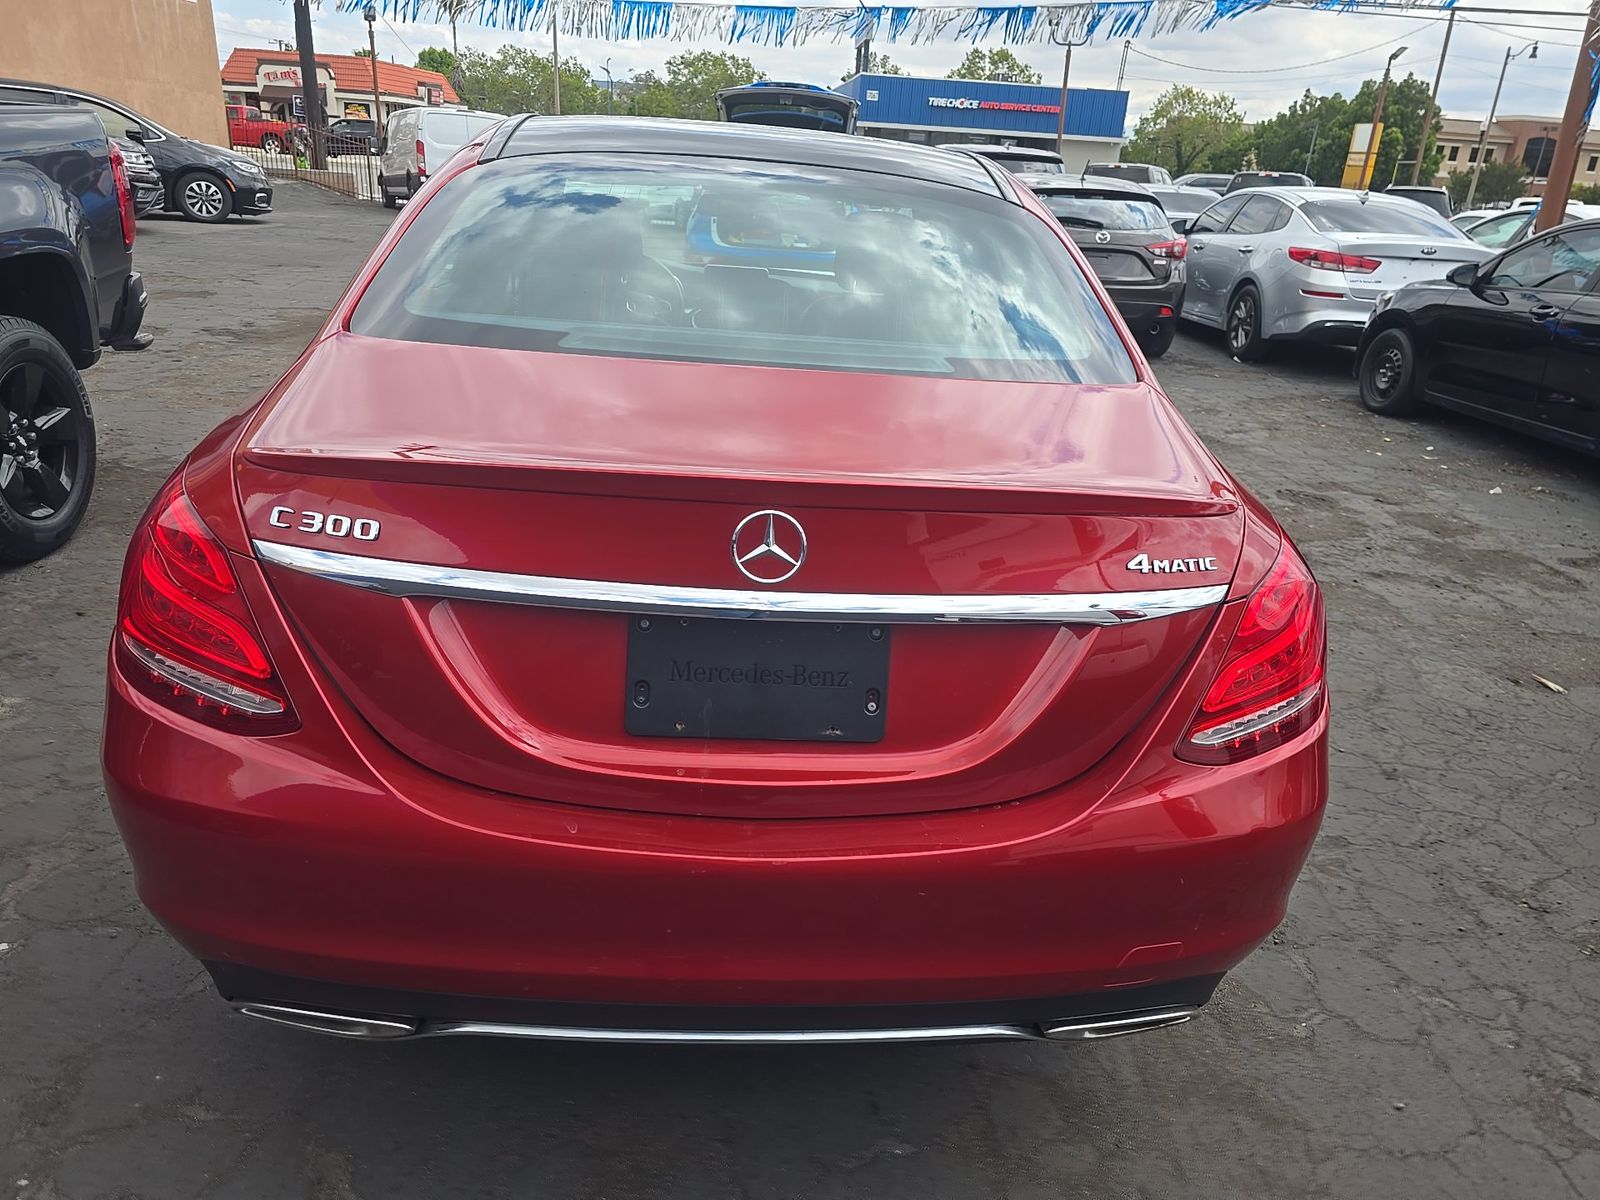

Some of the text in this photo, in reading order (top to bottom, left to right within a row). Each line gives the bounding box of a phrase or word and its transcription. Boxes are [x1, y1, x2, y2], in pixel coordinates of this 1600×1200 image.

[979, 101, 999, 110] AUTO
[999, 103, 1031, 112] SERVICE
[1031, 105, 1060, 114] CENTER
[269, 505, 381, 541] C 300
[1126, 553, 1218, 574] 4MATIC
[669, 659, 851, 688] Mercedes-Benz
